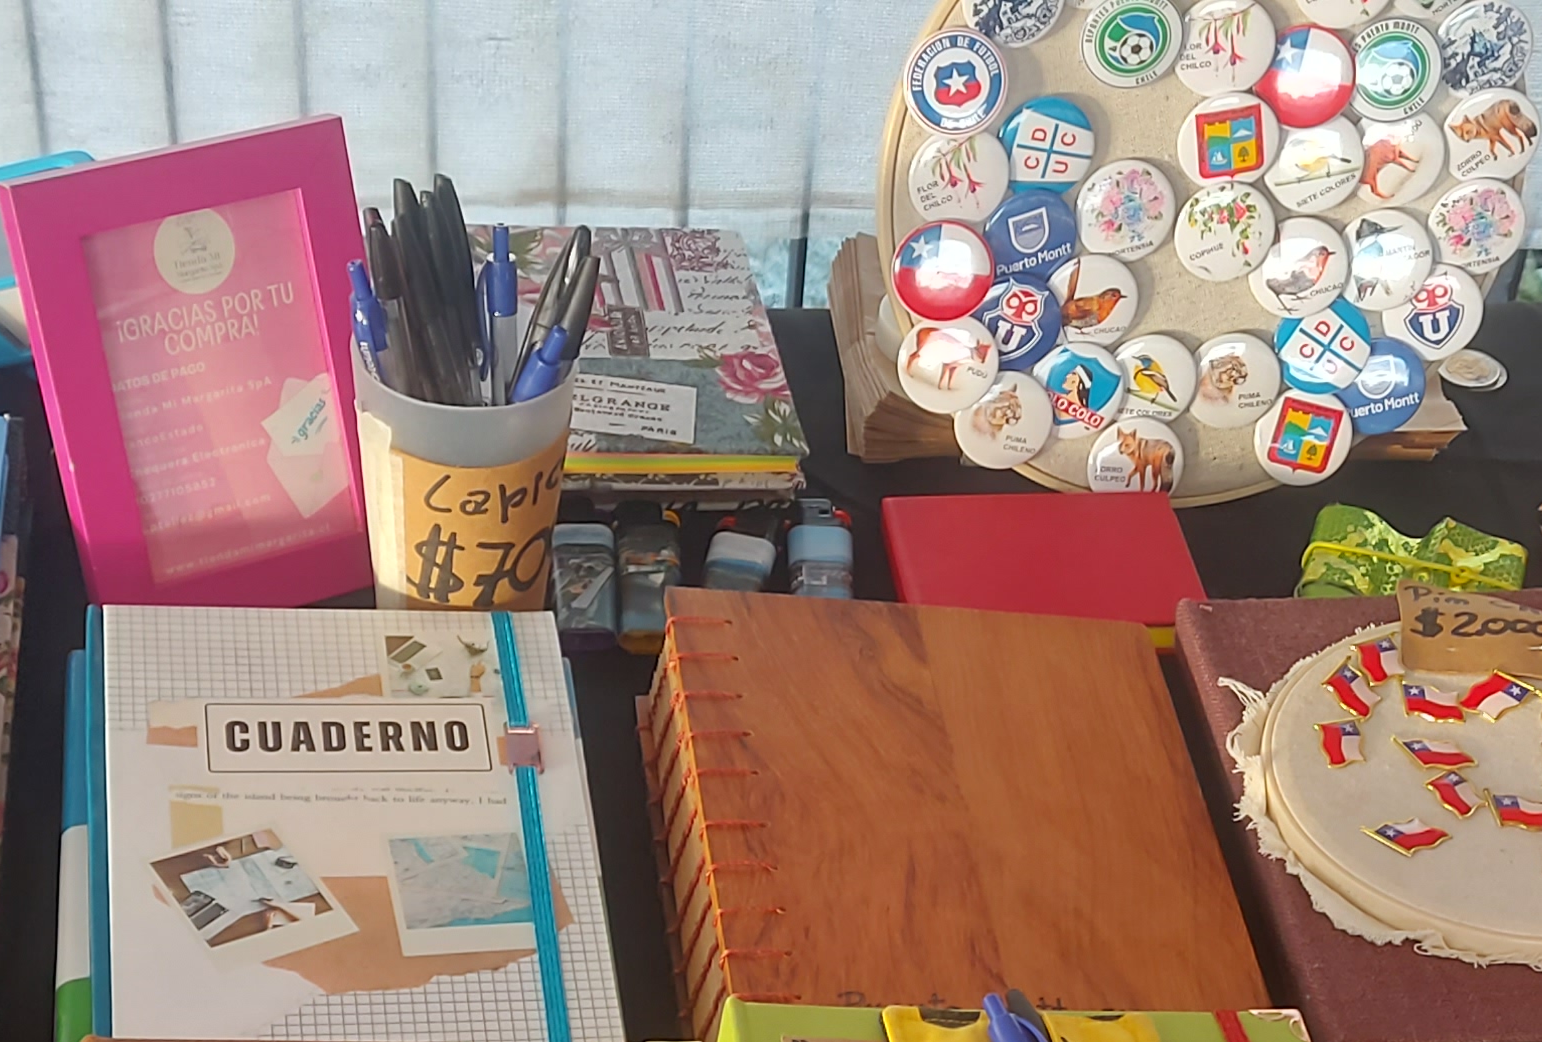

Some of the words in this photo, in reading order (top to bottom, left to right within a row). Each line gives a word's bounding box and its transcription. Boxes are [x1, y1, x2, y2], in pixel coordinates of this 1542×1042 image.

[911, 37, 952, 93] FEDERACION
[956, 35, 971, 49] DE
[972, 38, 1002, 78] FUTBOL
[916, 180, 940, 195] FLOR
[996, 254, 1039, 277] Puerto
[1038, 241, 1073, 266] Montt
[1309, 281, 1346, 298] CHUCAO
[116, 299, 218, 343] ¡GRACIAS
[221, 288, 265, 316] POR
[267, 281, 295, 307] TU
[163, 313, 260, 356] COMPRA!
[151, 370, 171, 385] DE
[171, 361, 207, 380] PAGO
[1237, 391, 1262, 402] PUMA
[1383, 390, 1421, 411] Montt
[1068, 402, 1104, 429] COLO
[128, 423, 205, 449] ancoEstado
[224, 719, 472, 754] CUADERNO
[222, 791, 241, 801] the
